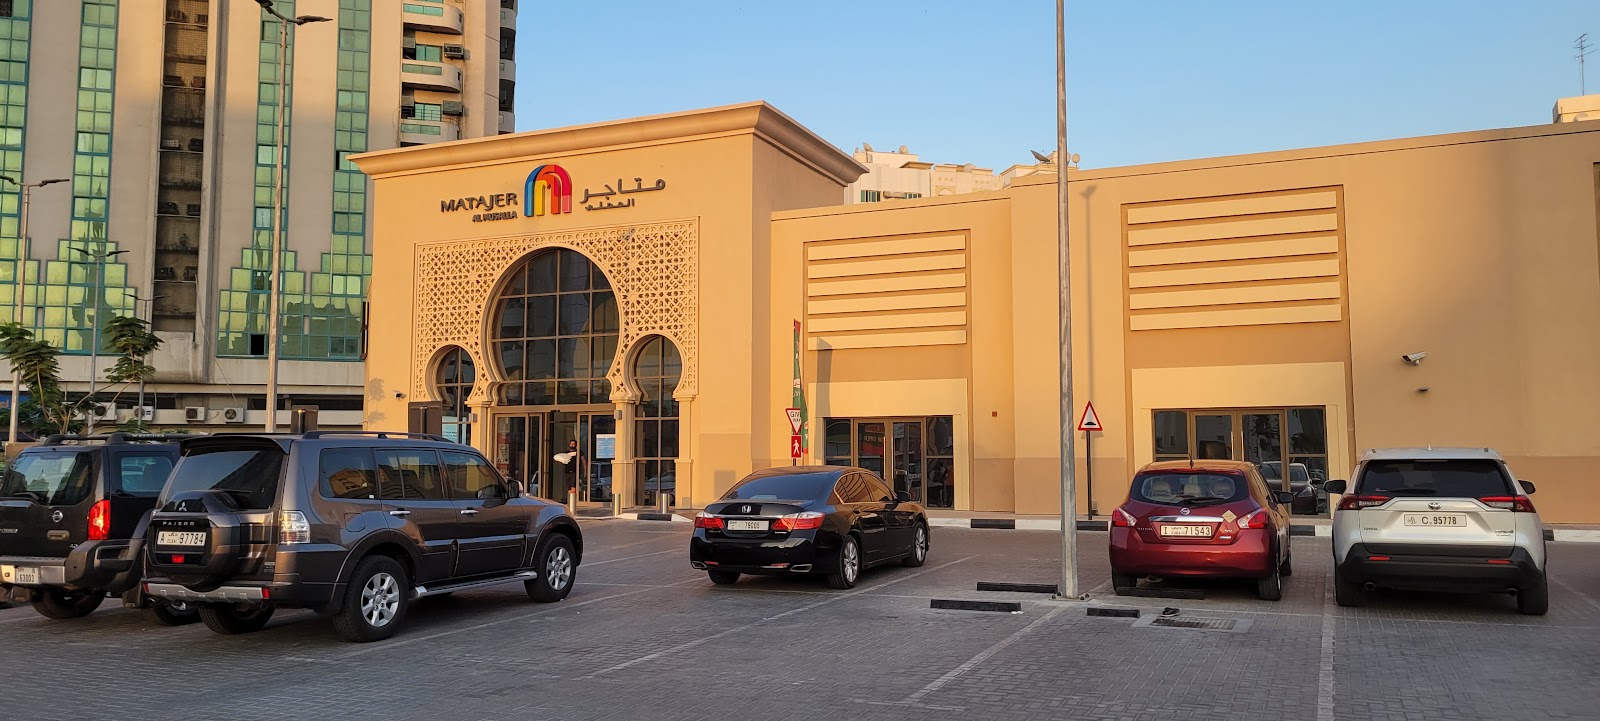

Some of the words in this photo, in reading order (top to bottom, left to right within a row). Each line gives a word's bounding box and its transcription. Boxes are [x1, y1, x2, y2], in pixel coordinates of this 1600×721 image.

[579, 177, 666, 204] متاجر
[440, 192, 518, 213] MATAJER
[472, 214, 482, 222] AL
[483, 211, 518, 221] MUSALLA
[1421, 516, 1429, 525] C
[1433, 515, 1457, 525] 95778
[1184, 526, 1211, 536] 71543
[160, 533, 165, 543] A
[179, 532, 204, 545] 97784
